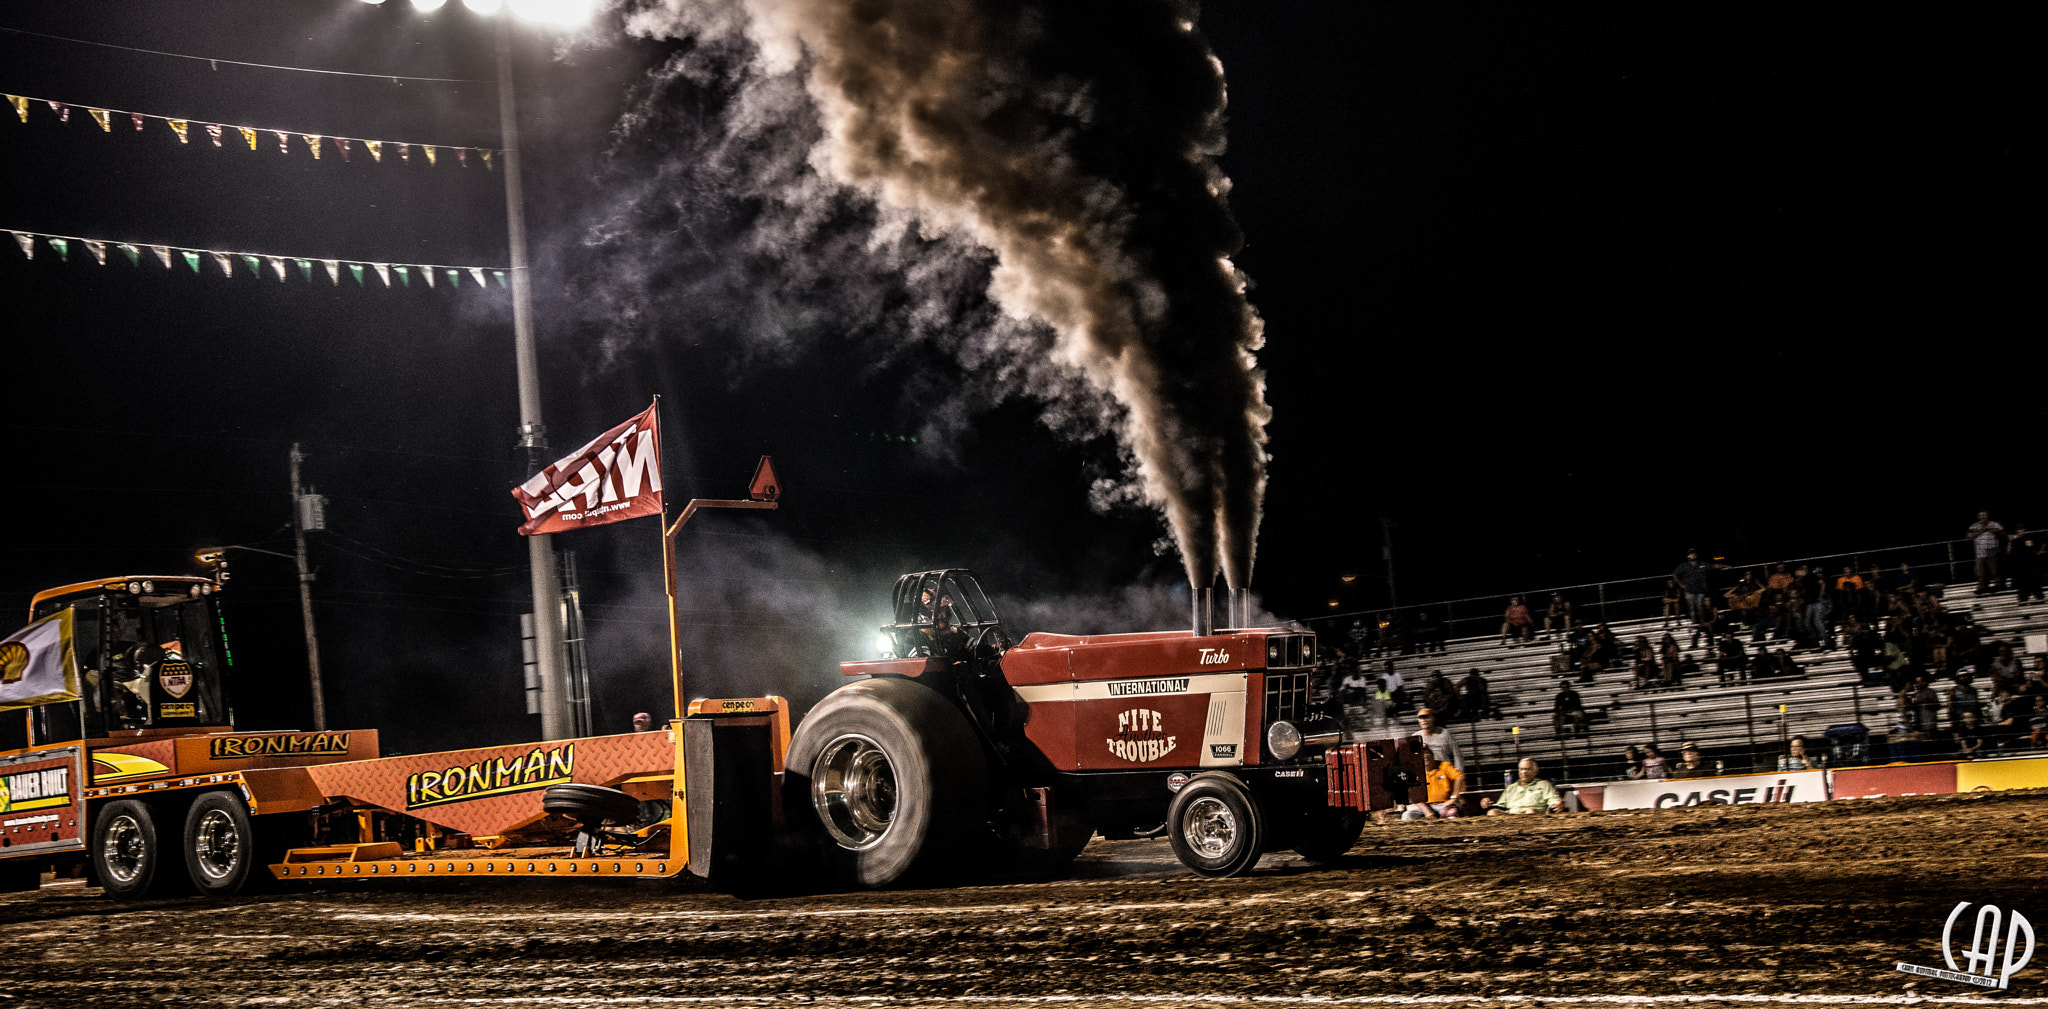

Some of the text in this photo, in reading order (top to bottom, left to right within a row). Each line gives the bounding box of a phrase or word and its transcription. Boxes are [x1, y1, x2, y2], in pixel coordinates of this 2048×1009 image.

[1199, 648, 1230, 665] Turbo
[1110, 679, 1187, 695] INTERNATIONAL
[1118, 708, 1163, 732] NITE
[1112, 724, 1168, 742] Another
[209, 732, 350, 757] IRONMAN
[1106, 735, 1177, 762] TROUBLE
[9, 768, 68, 800] BAUER BUILT
[406, 743, 574, 803] IRONMAN
[1275, 770, 1296, 778] CASE
[1655, 788, 1758, 808] CASE
